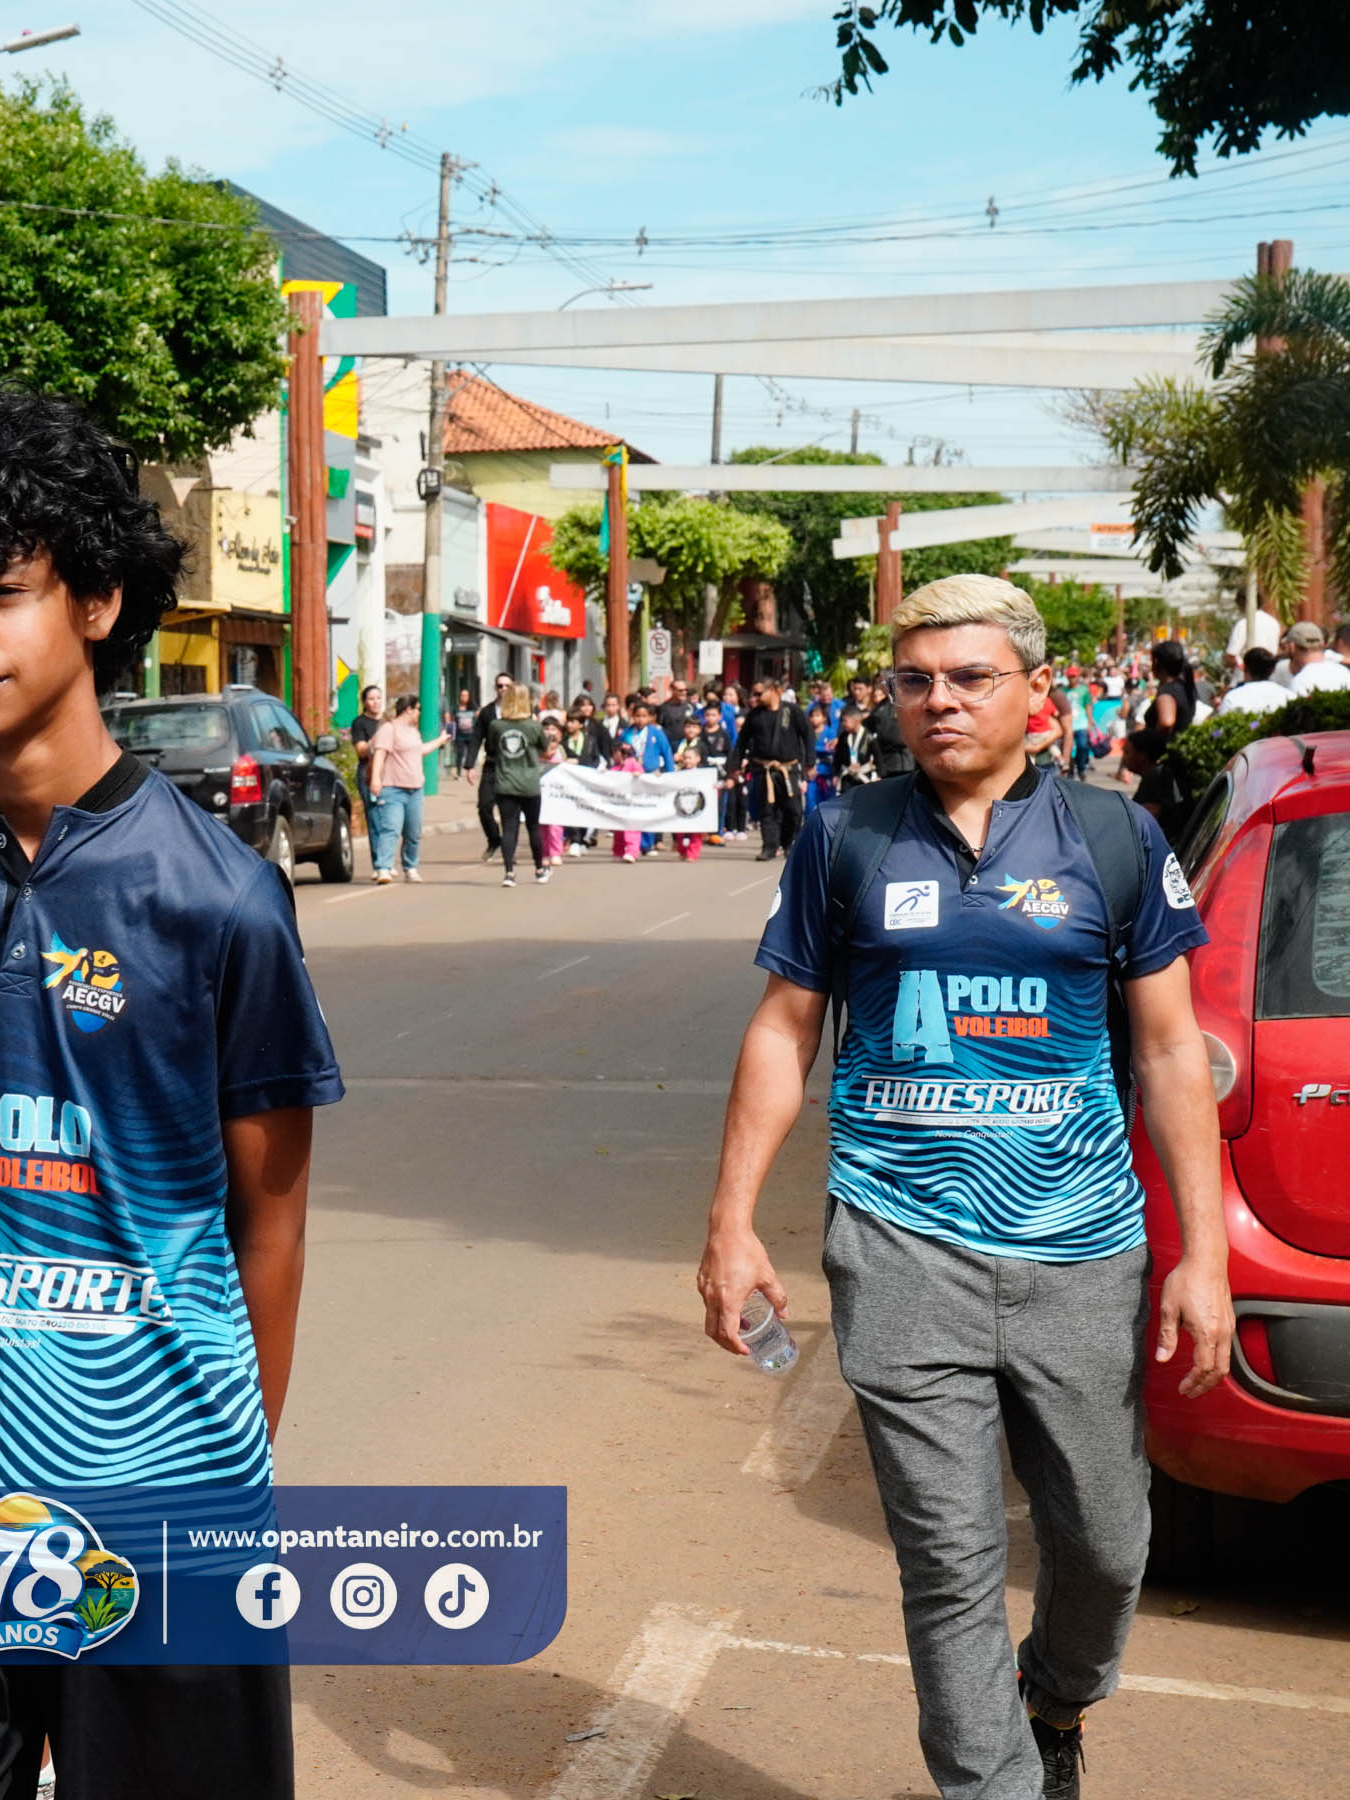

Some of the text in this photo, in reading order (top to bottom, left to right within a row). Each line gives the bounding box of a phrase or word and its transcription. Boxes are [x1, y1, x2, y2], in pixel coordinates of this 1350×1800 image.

[1022, 902, 1069, 915] AECGV
[62, 985, 126, 1013] AECGV
[954, 1016, 1052, 1038] VOLEIBOL
[865, 1080, 1087, 1112] FUNDESPORTE
